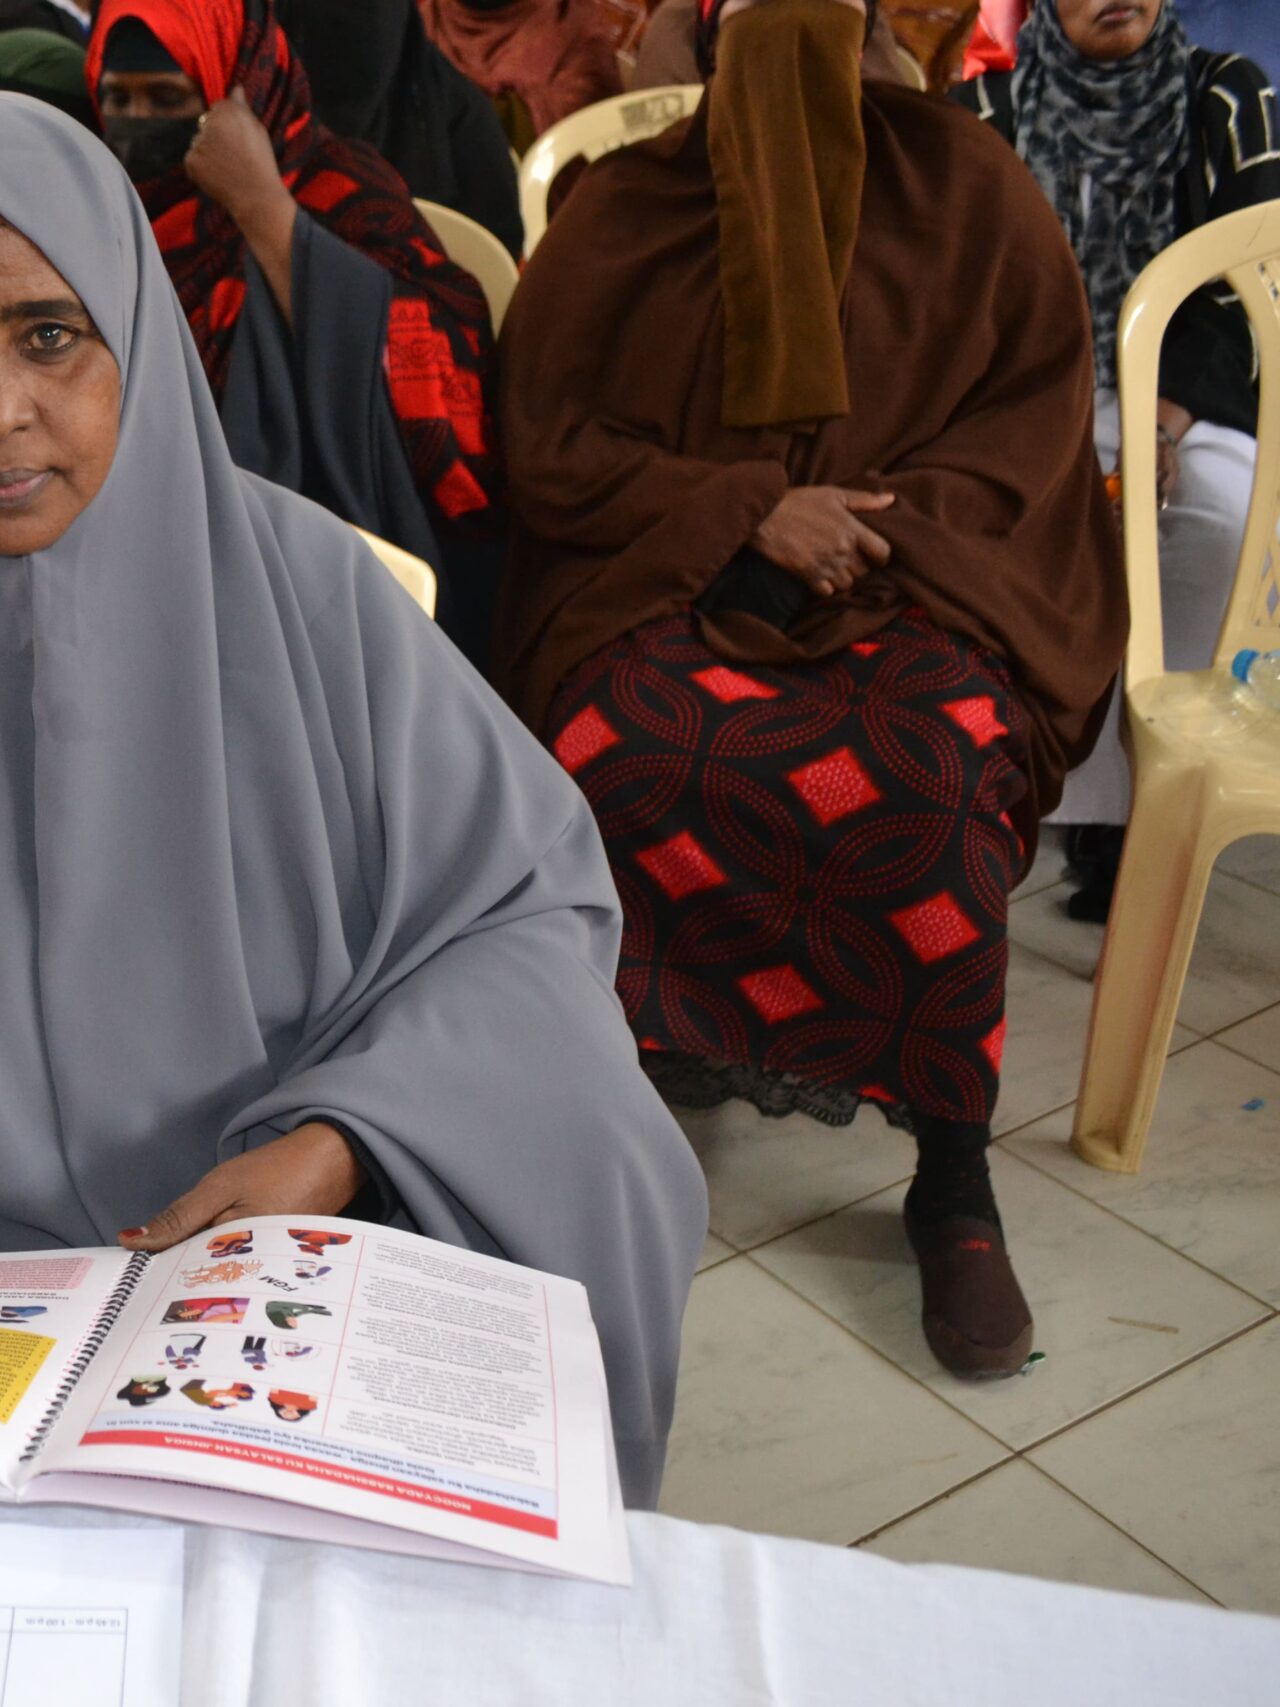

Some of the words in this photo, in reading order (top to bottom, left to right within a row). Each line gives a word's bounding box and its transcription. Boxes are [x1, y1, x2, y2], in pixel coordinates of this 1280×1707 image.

[258, 1275, 299, 1292] FGM
[164, 1437, 212, 1448] JINSIGA
[215, 1444, 283, 1463] SALAYSAN
[285, 1459, 303, 1468] KU
[306, 1464, 393, 1490] RABSHADAHA
[396, 1486, 470, 1510] NOOCYADA
